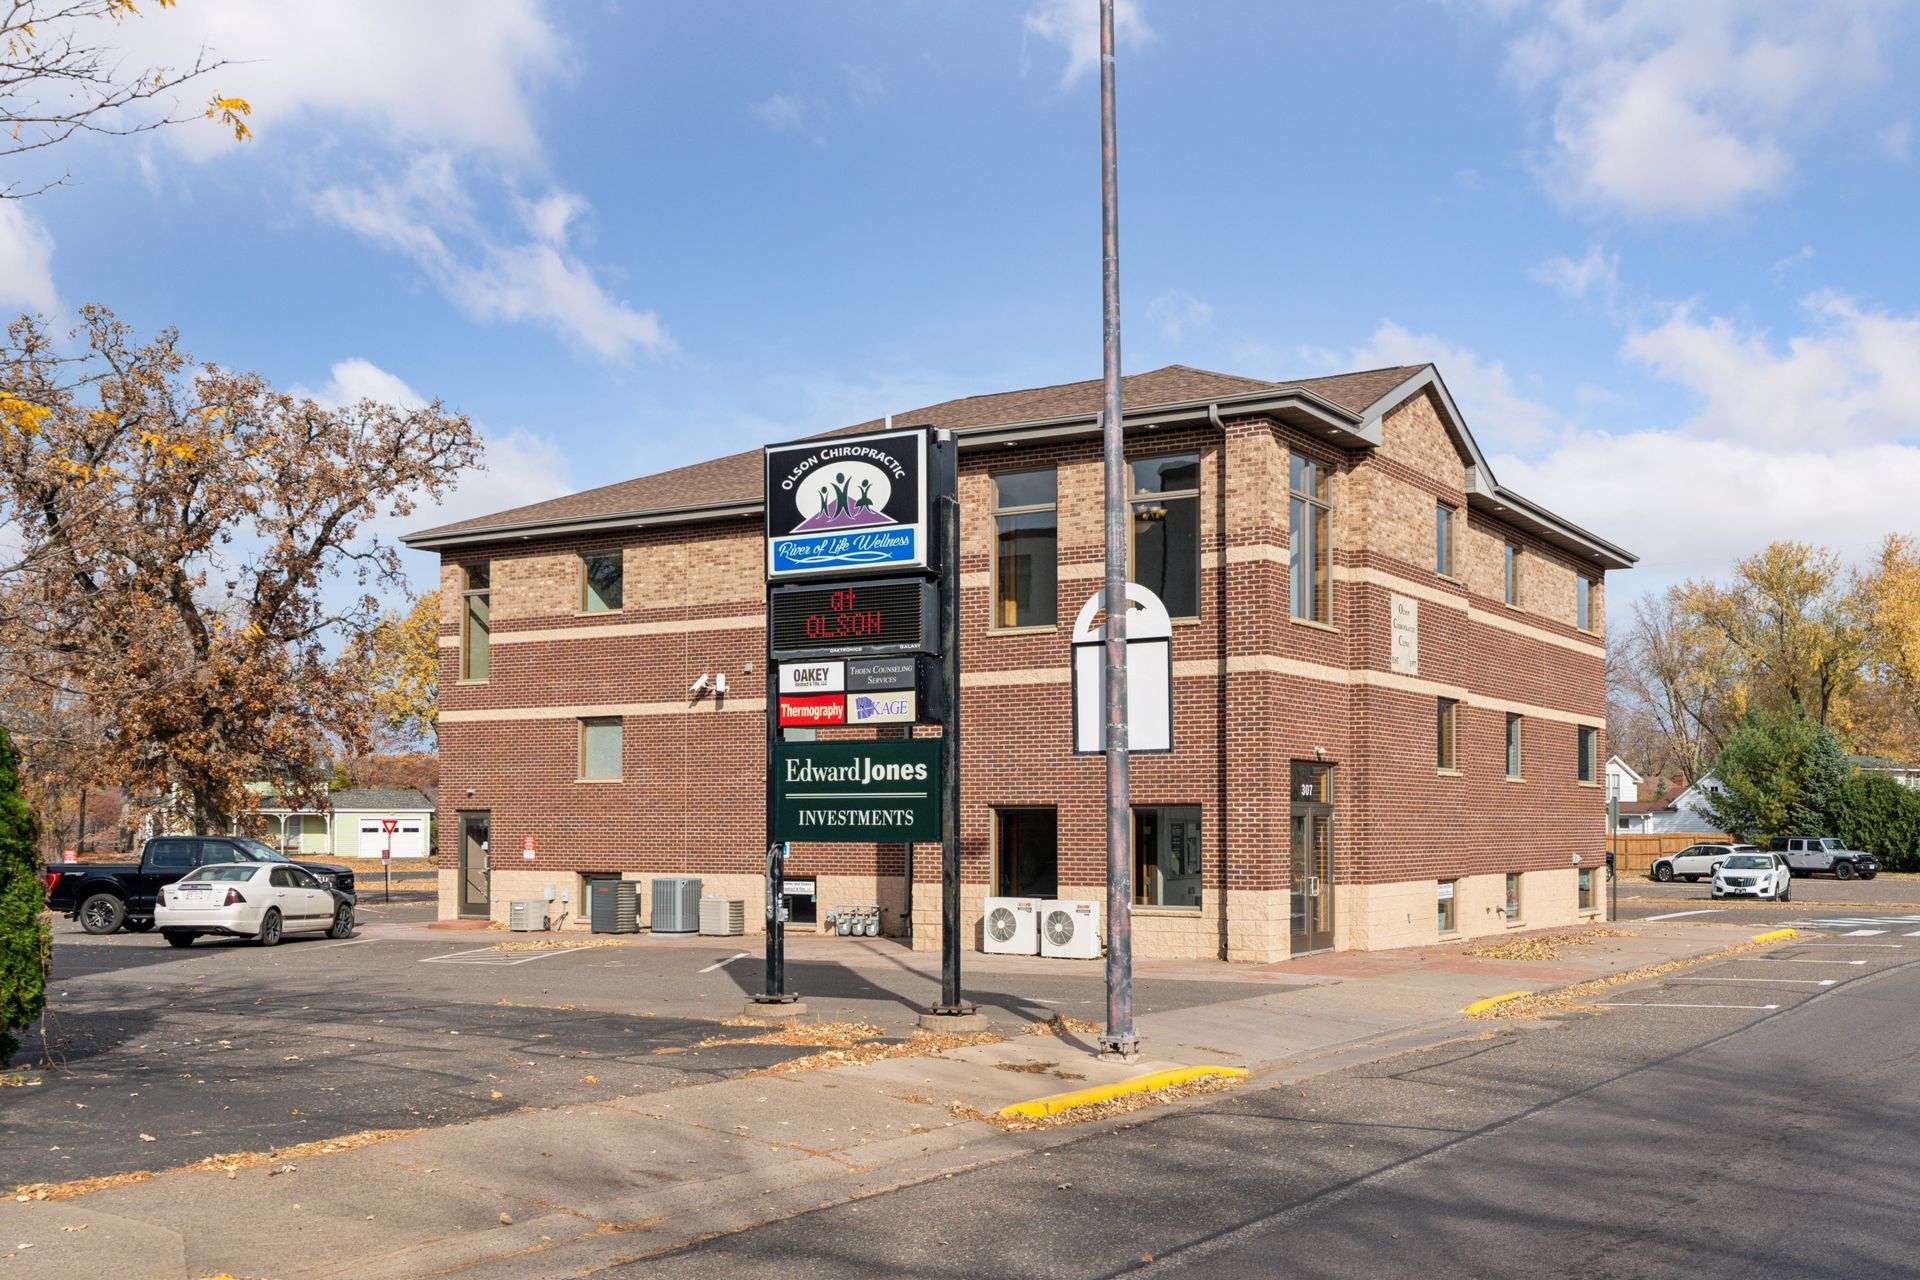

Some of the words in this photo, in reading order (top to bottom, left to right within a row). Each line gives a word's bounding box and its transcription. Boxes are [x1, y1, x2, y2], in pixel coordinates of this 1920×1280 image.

[781, 455, 818, 491] OLSON
[820, 446, 905, 480] CHIROPRACTIC
[779, 542, 811, 558] River
[813, 539, 828, 556] of
[829, 537, 850, 555] Life
[853, 533, 909, 551] Wellness
[806, 611, 881, 638] OLSON
[793, 668, 829, 682] OAKEY
[849, 666, 872, 675] THOEN
[872, 665, 913, 674] COUNSELING
[867, 676, 897, 684] SERVICES
[781, 703, 844, 719] Thermography
[871, 701, 908, 715] KAGE
[785, 758, 860, 782] Edward
[861, 758, 928, 784] Jones
[1301, 784, 1313, 796] 307
[798, 809, 914, 826] INVESTMENTS
